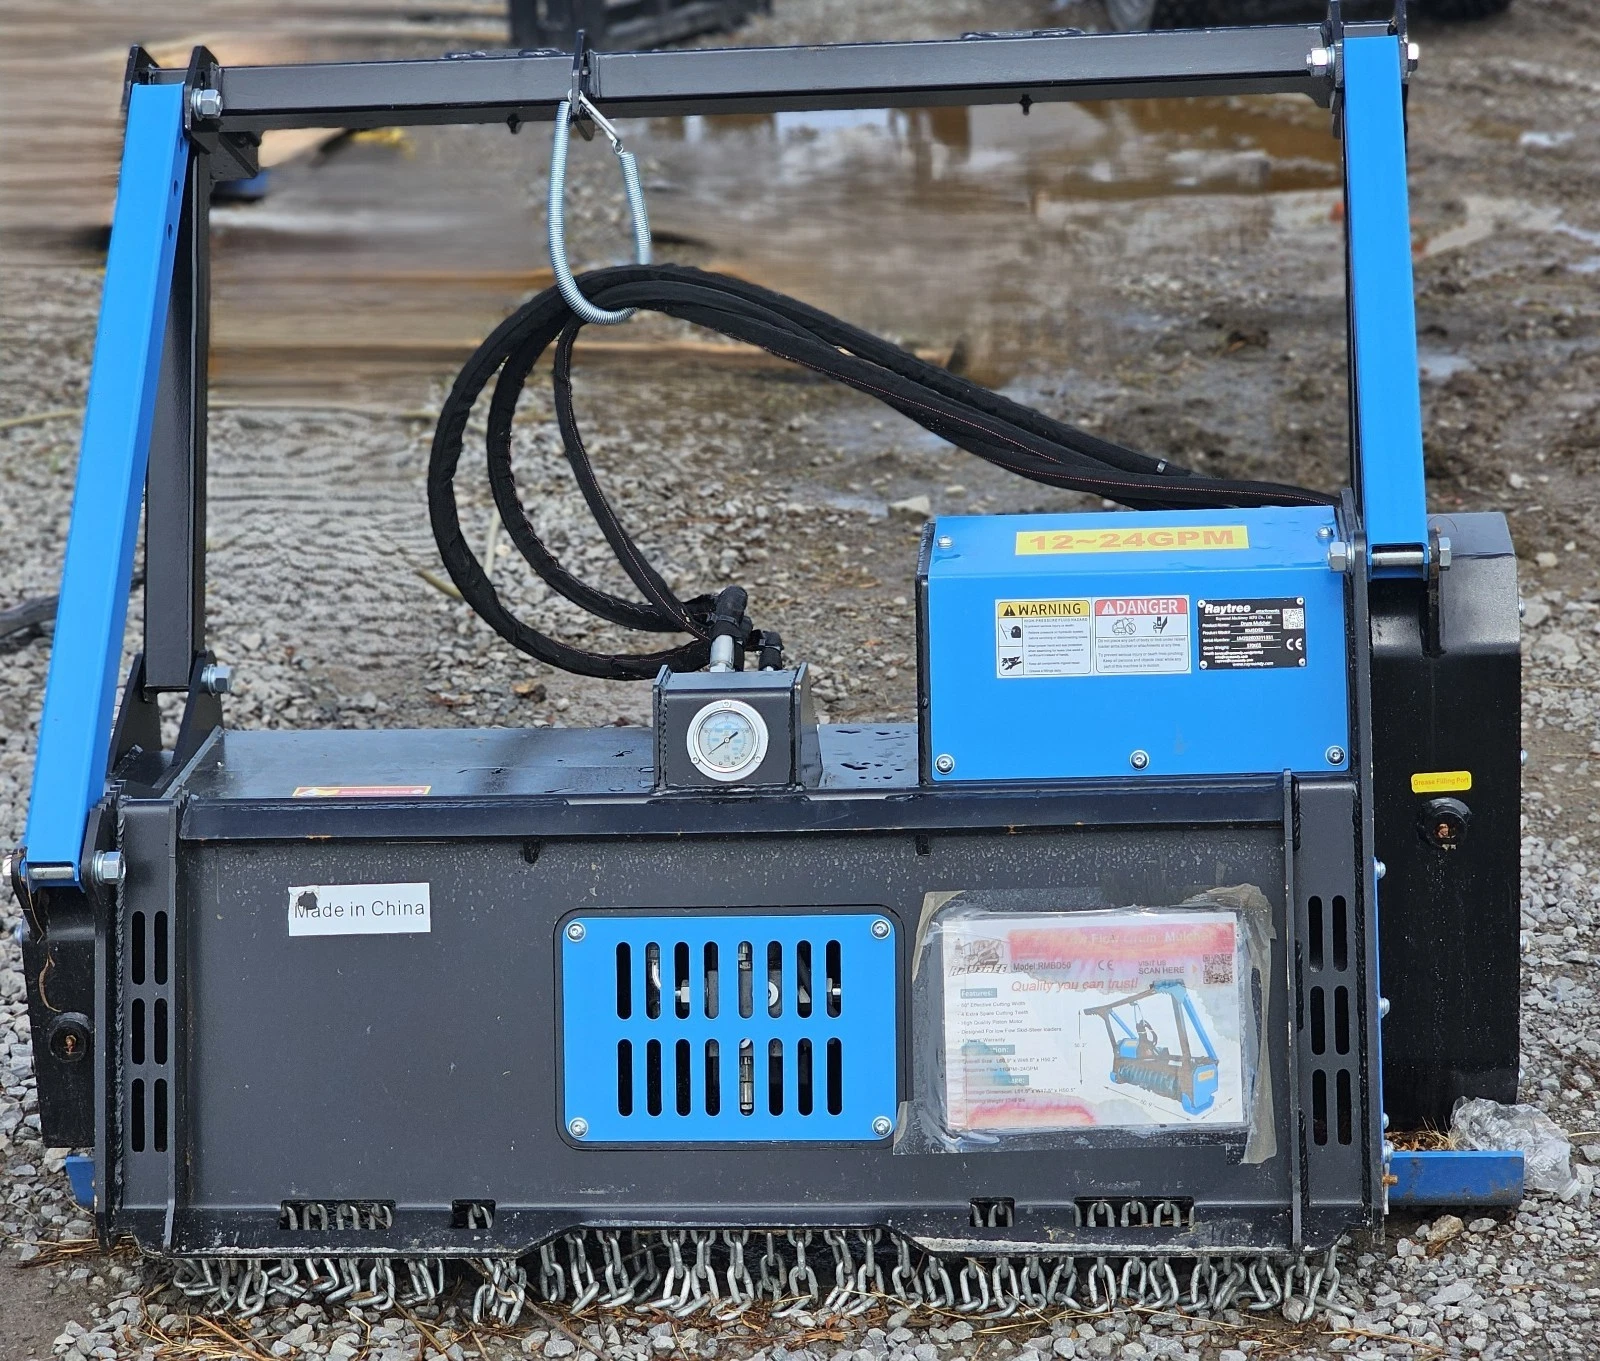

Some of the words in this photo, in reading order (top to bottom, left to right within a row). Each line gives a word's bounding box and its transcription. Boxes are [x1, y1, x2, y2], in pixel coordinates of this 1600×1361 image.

[1030, 530, 1234, 550] 12~24GPM
[1018, 603, 1081, 616] WARNING
[1116, 599, 1178, 615] DANGER
[1204, 604, 1251, 615] Raytree
[1436, 777, 1456, 785] Filling
[1456, 776, 1469, 784] Port
[294, 902, 344, 918] Made
[350, 901, 365, 917] in
[371, 899, 425, 917] China
[1138, 967, 1160, 975] SCAN
[1162, 966, 1185, 974] HERE
[1011, 980, 1053, 993] Quality
[1056, 981, 1078, 993] you
[1082, 980, 1104, 989] can
[1108, 977, 1138, 989] trust!
[961, 989, 992, 998] Features:
